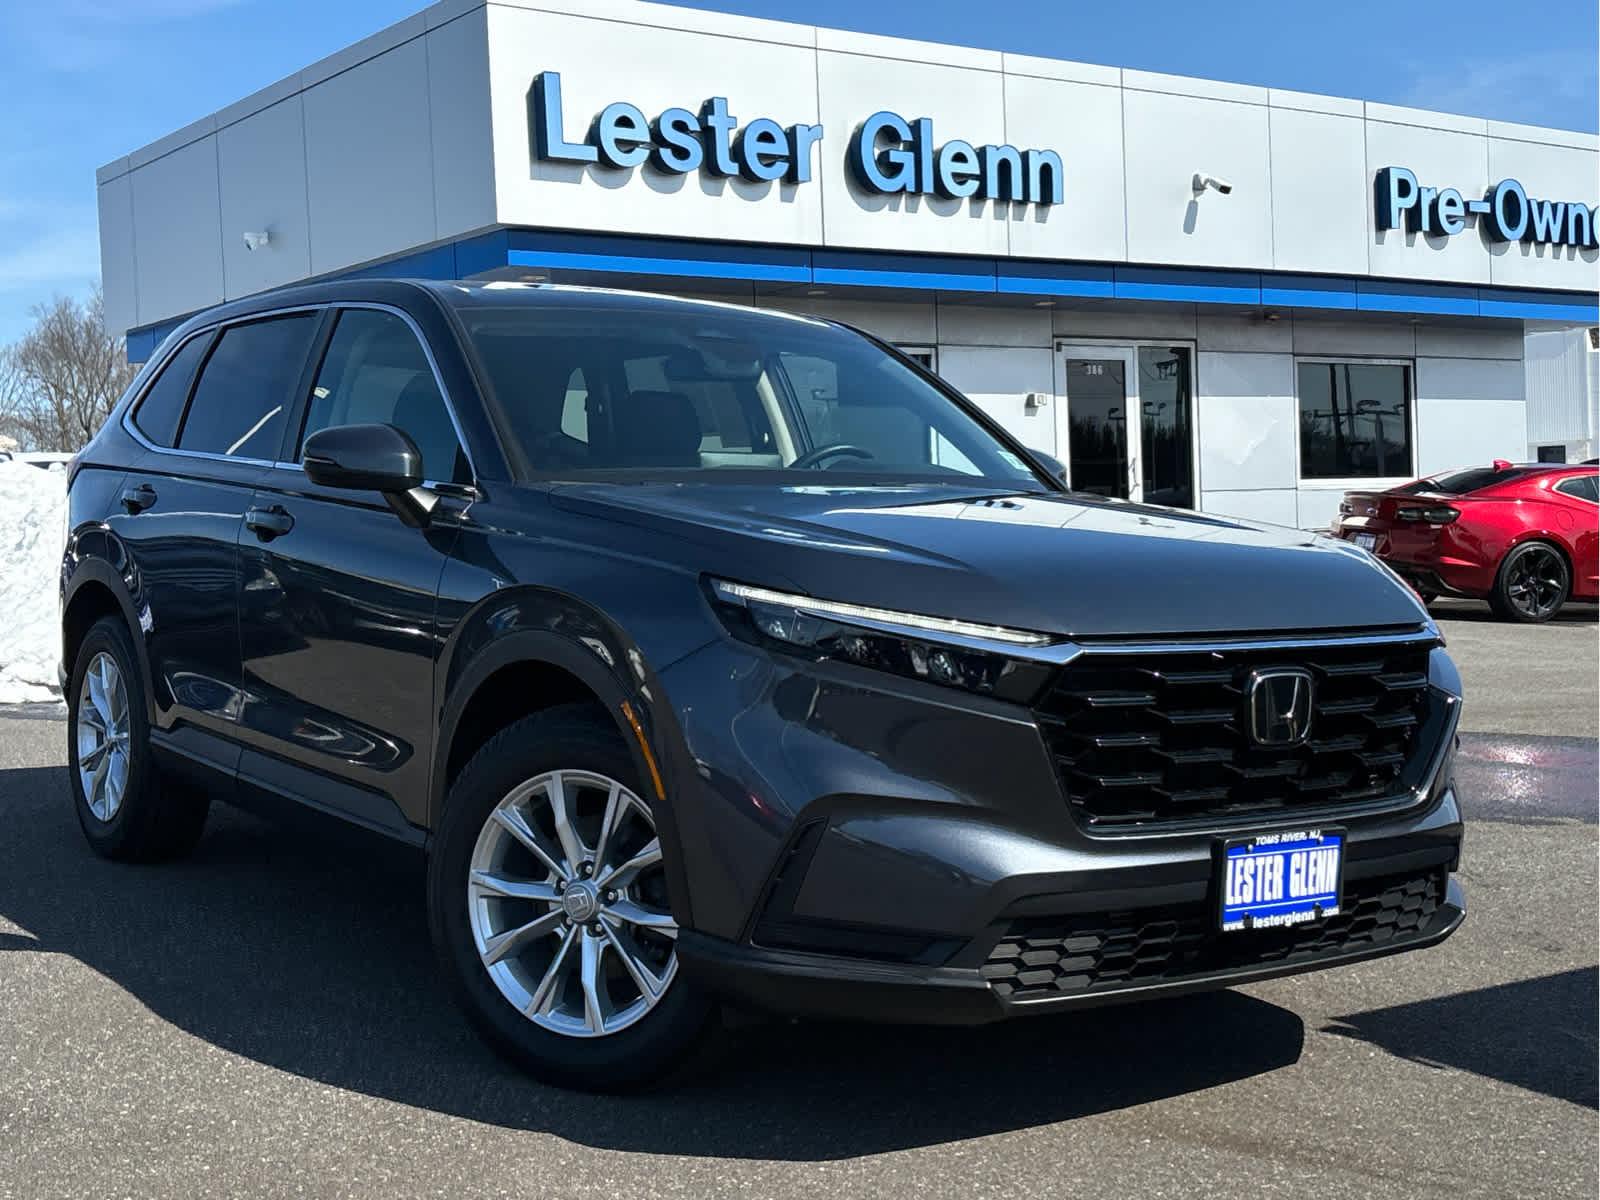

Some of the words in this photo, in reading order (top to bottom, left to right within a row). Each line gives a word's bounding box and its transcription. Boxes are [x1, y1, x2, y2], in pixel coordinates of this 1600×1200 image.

[538, 71, 824, 183] Lester
[856, 110, 1064, 205] Glenn
[1255, 834, 1280, 846] TOMS
[1225, 854, 1284, 906] LESTER
[1289, 848, 1339, 898] GLENN
